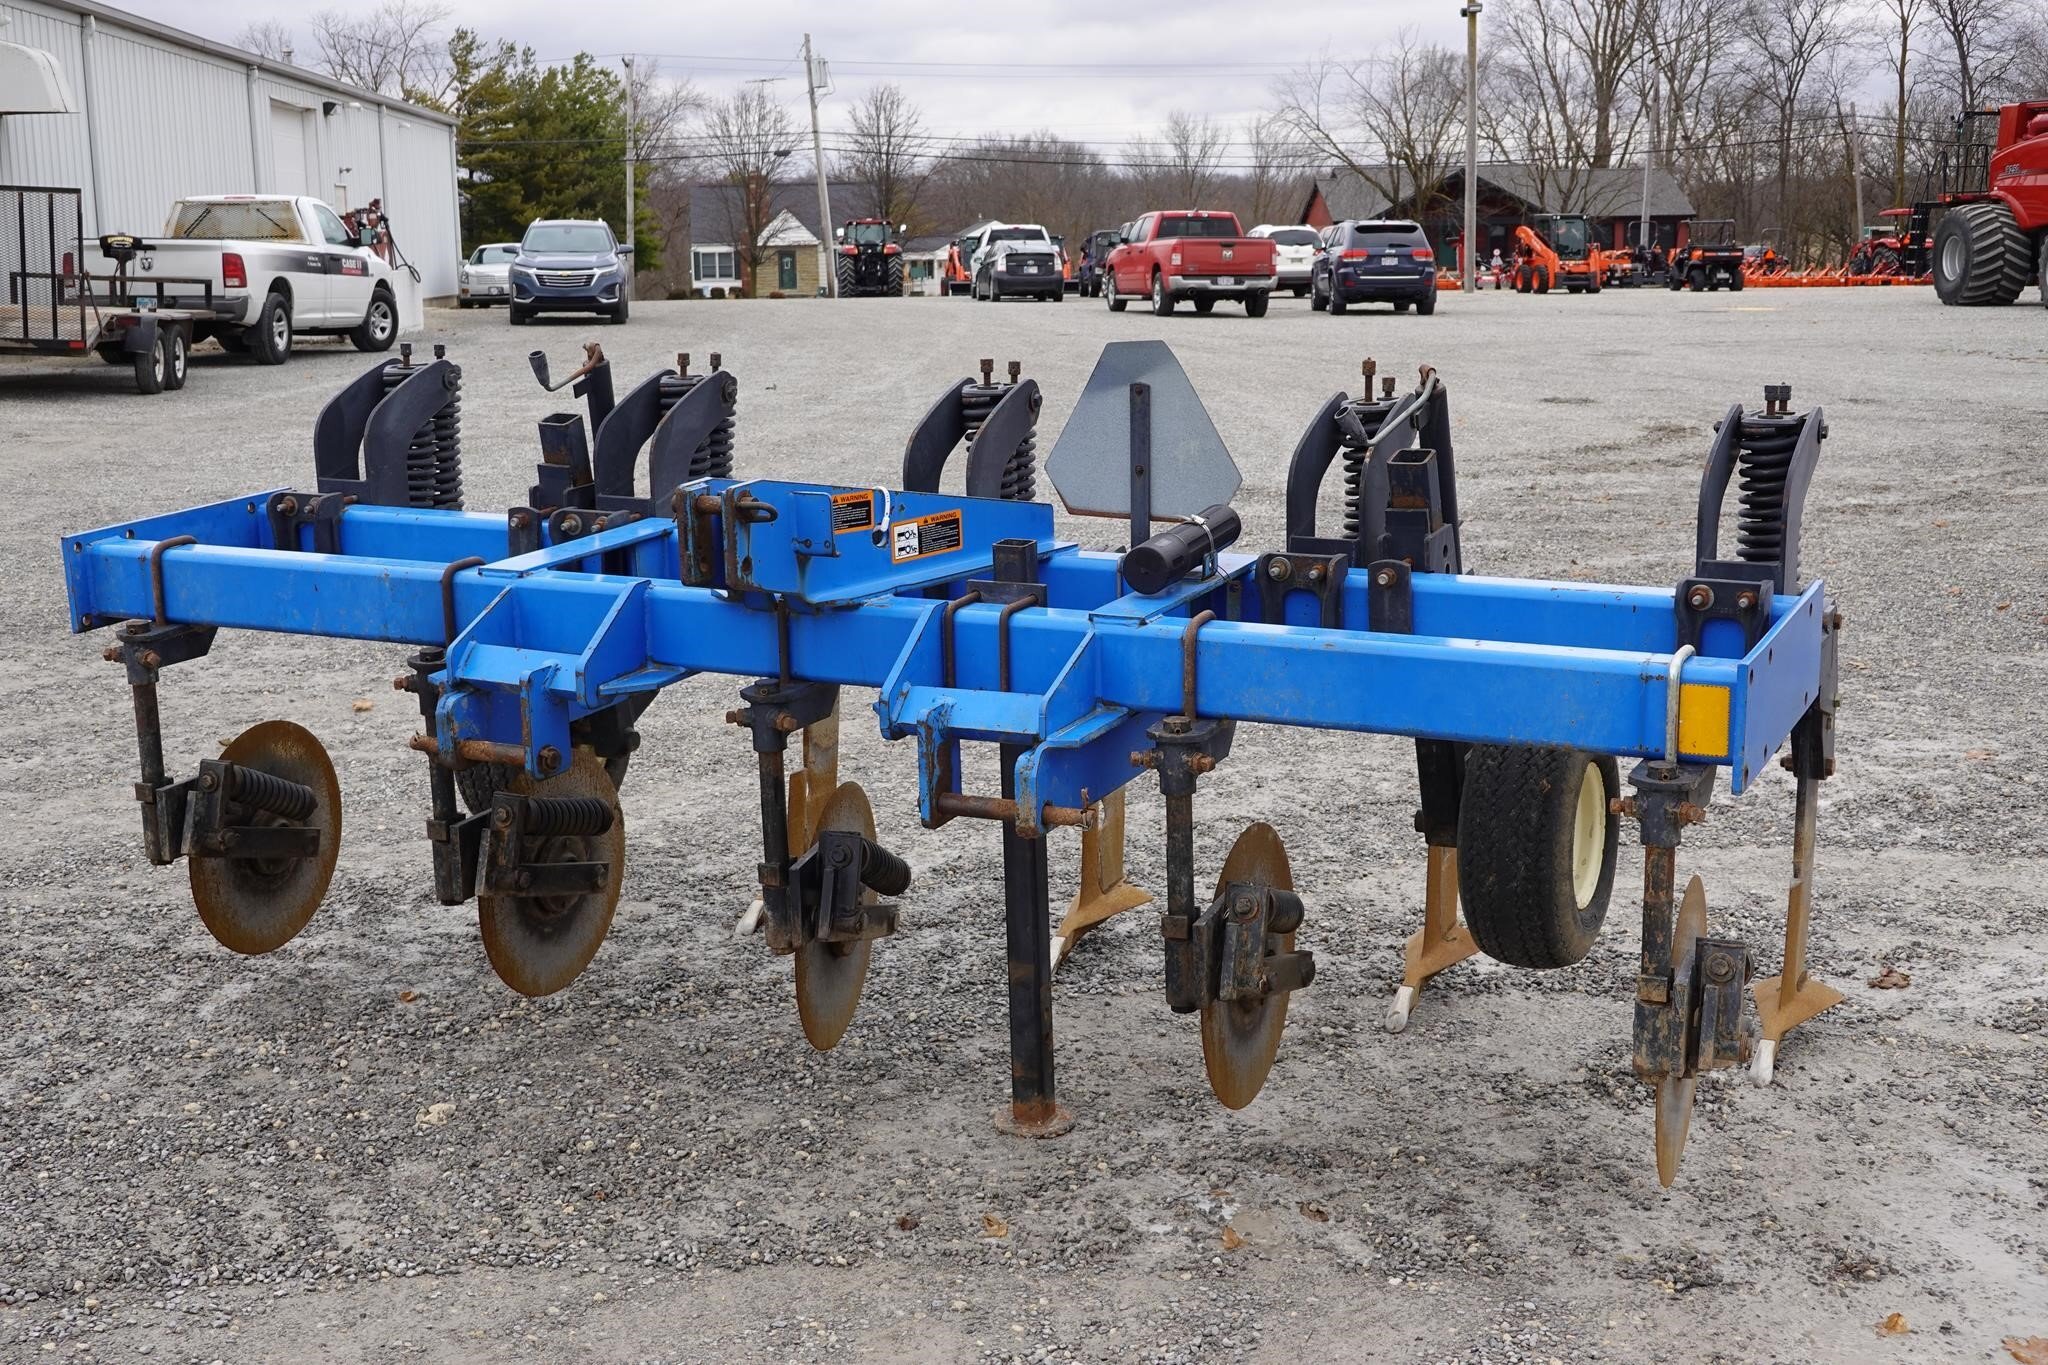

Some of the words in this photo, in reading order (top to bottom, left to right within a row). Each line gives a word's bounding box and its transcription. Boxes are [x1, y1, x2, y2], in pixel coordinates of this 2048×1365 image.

[342, 258, 356, 269] CASE
[840, 493, 869, 502] WARNING
[930, 511, 957, 522] WARNING
